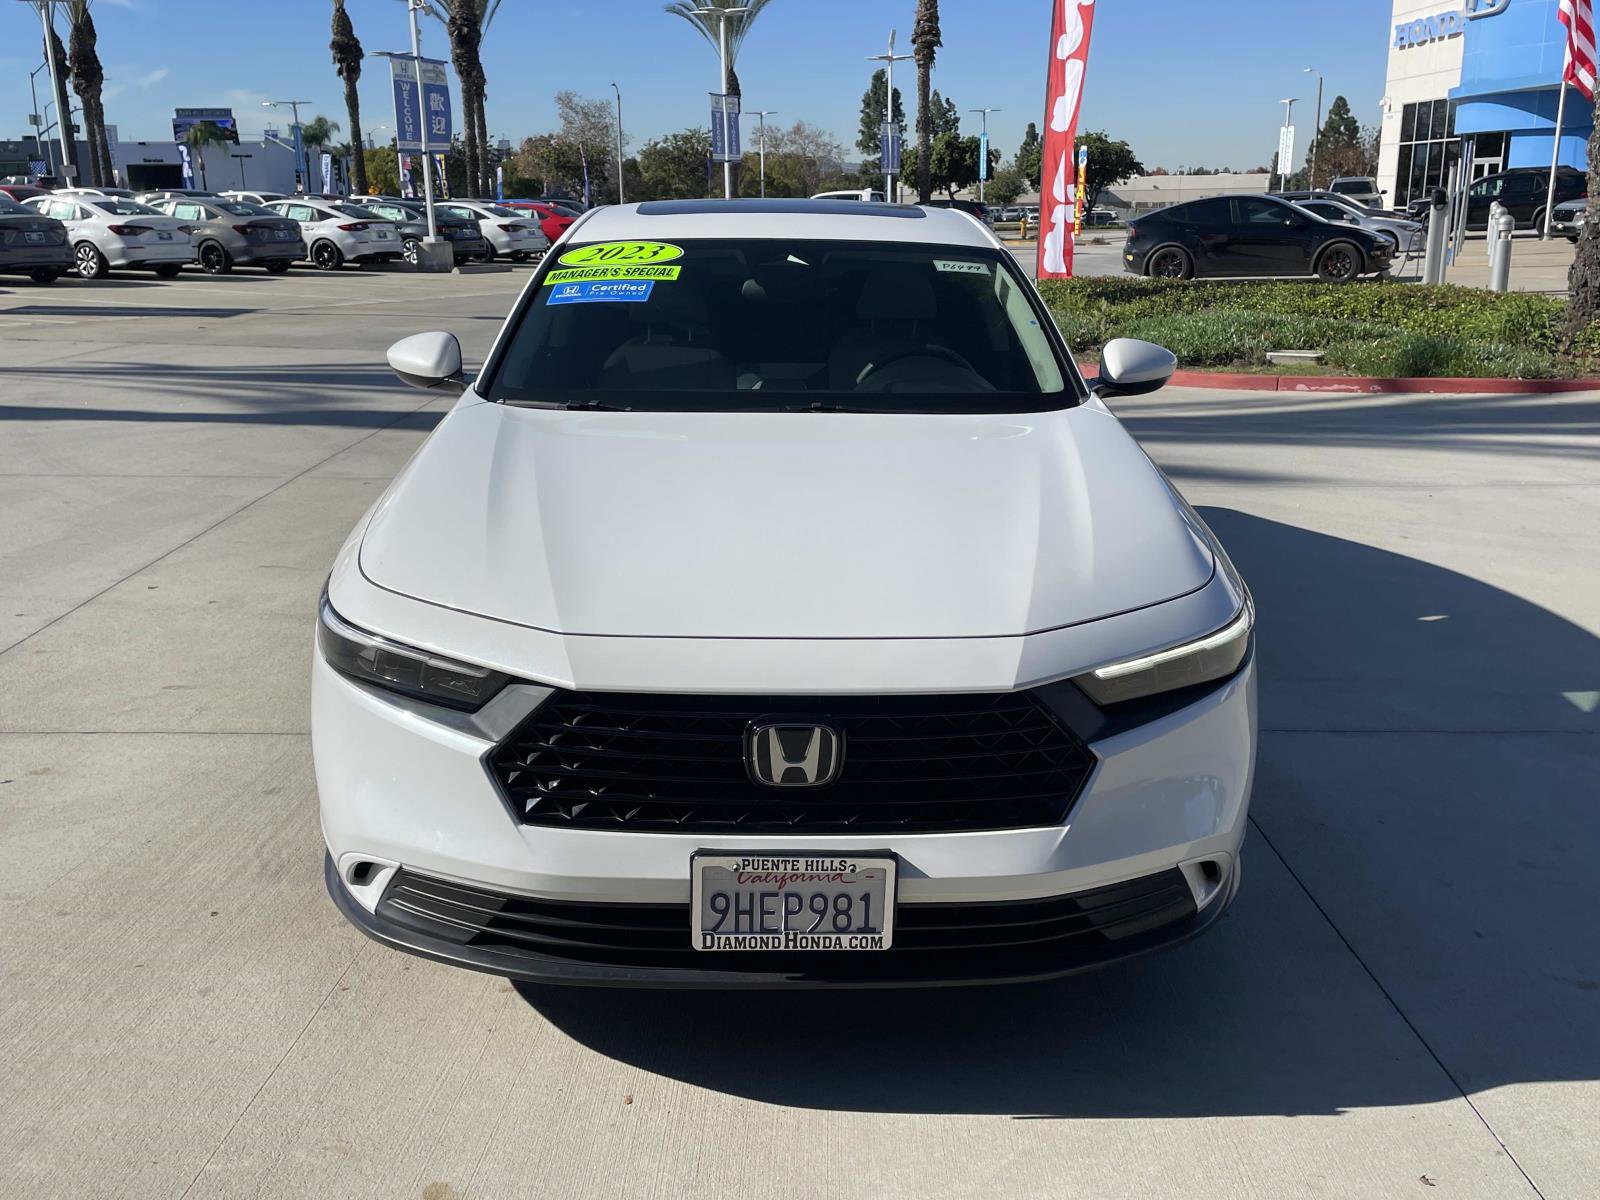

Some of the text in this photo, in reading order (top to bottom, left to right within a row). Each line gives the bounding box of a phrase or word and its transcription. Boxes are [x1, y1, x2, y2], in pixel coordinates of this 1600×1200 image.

[1394, 11, 1465, 47] HOND
[401, 82, 413, 140] WELCOME
[577, 245, 666, 263] 2023
[549, 266, 674, 282] MANAGER'S SPECIAL
[742, 859, 847, 872] PUENTE HILLS
[736, 872, 856, 890] California
[709, 892, 878, 934] 9HEP981
